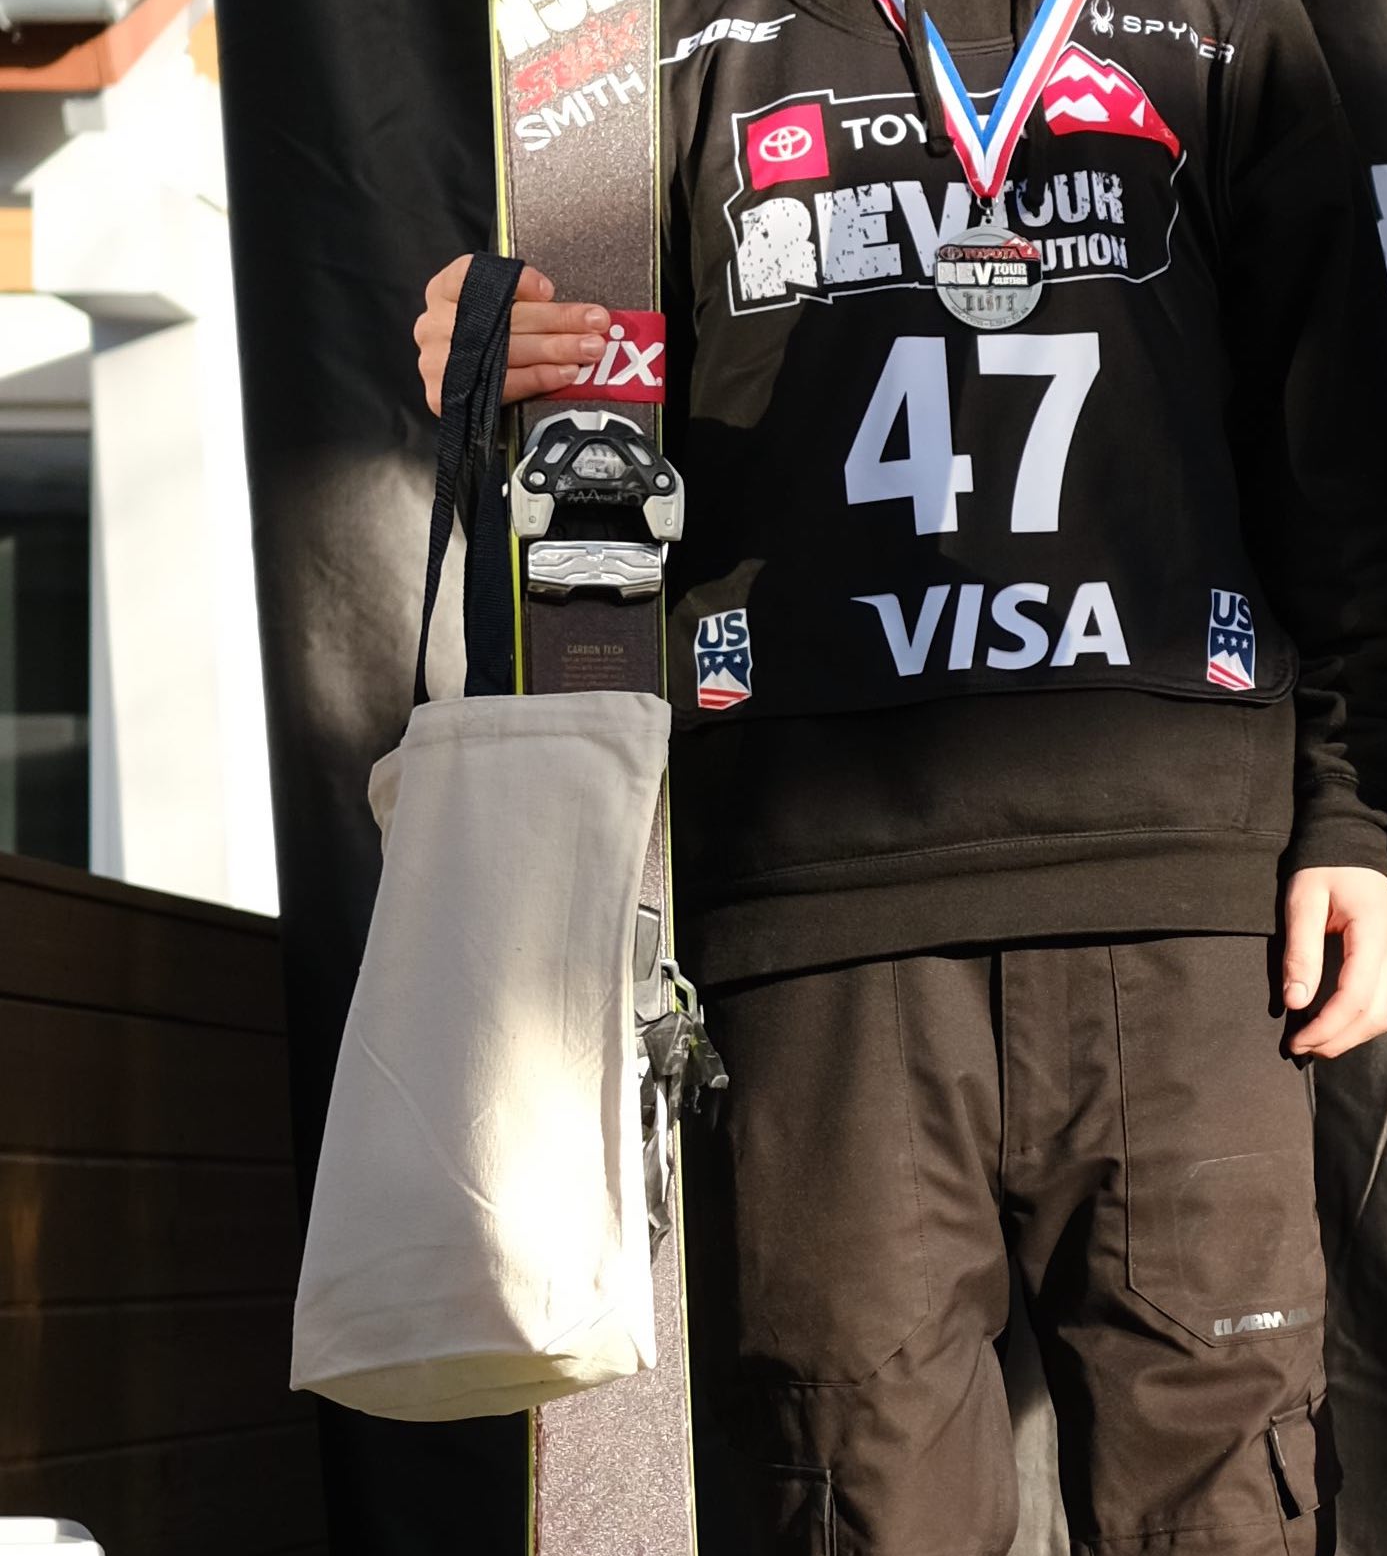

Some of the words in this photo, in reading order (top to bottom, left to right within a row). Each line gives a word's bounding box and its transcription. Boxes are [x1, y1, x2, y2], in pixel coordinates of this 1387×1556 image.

[660, 13, 797, 66] BOSE
[1121, 14, 1236, 65] SPYDER
[514, 63, 647, 152] SMITH
[736, 179, 973, 302] REV
[1041, 232, 1129, 270] UTION
[992, 262, 1028, 276] TOUR
[572, 323, 664, 387] ix
[844, 331, 1101, 536] 47
[698, 611, 748, 649] US
[850, 581, 1131, 677] VISA
[1212, 591, 1253, 632] US
